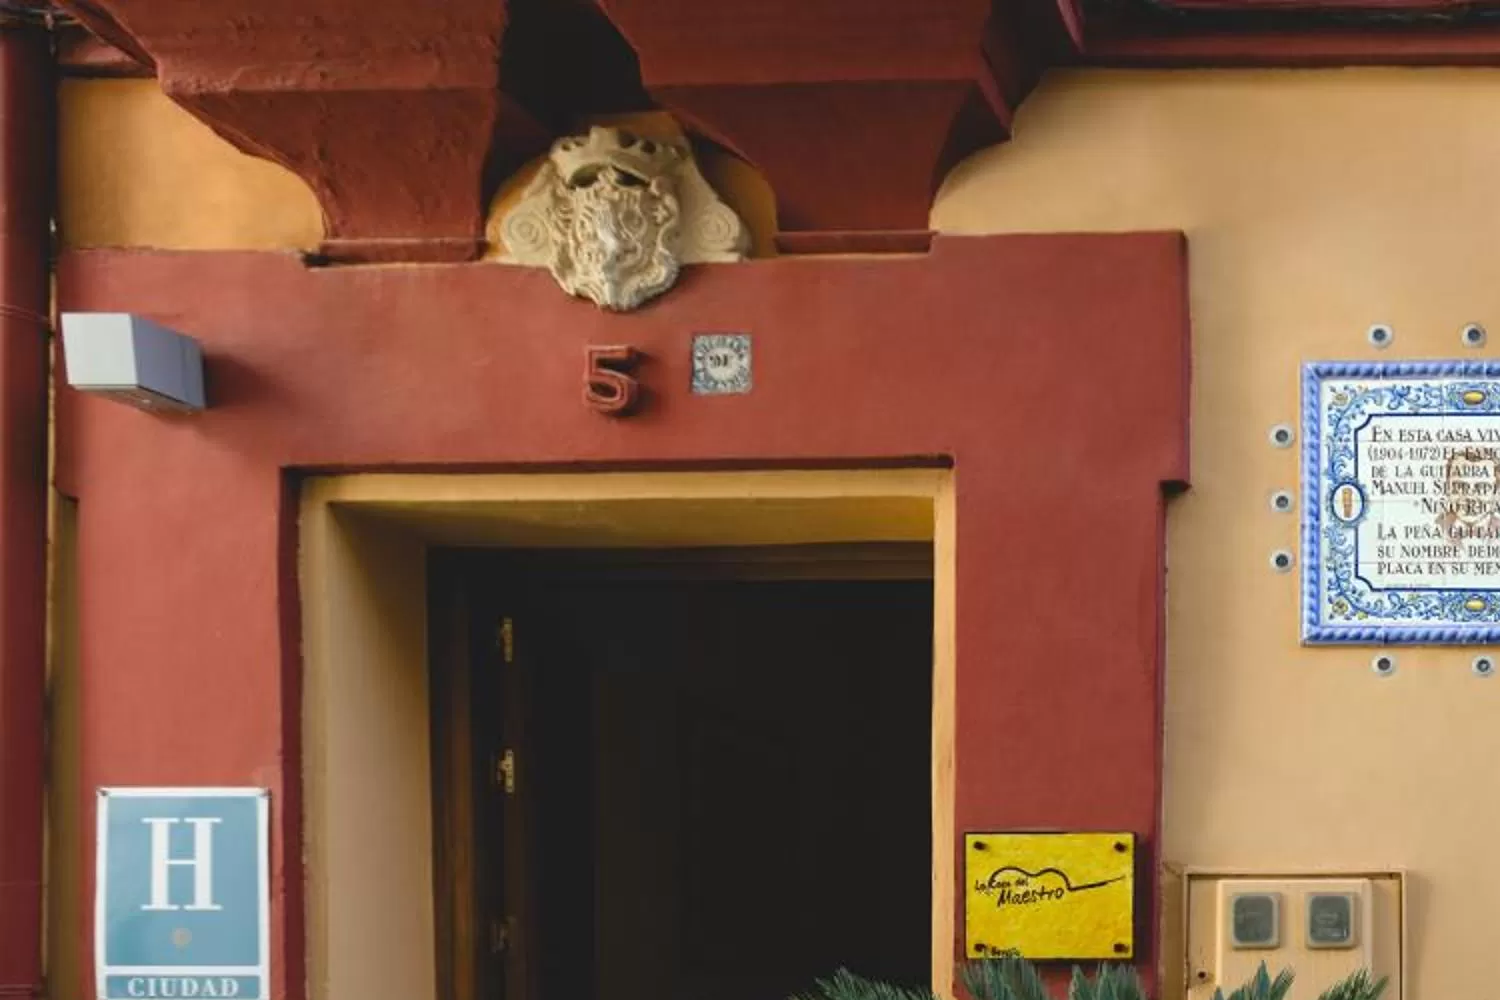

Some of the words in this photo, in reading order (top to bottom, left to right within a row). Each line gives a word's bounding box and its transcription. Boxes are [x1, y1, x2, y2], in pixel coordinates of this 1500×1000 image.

[583, 345, 636, 413] 5
[1371, 425, 1392, 442] EN
[1399, 428, 1432, 442] ESTA
[1435, 428, 1472, 442] CASA
[1371, 465, 1387, 478] DE
[1394, 465, 1413, 478] LA
[1370, 480, 1429, 496] MANUEL
[1377, 522, 1397, 541] LA
[1403, 523, 1442, 539] PEÑA
[1377, 545, 1395, 558] SU
[1400, 545, 1460, 558] NOMBRE
[1377, 562, 1423, 576] PLACA
[1427, 562, 1446, 576] EN
[1450, 562, 1469, 576] SU
[141, 816, 222, 911] H
[997, 885, 1065, 908] Maestro
[127, 977, 240, 997] CIUDAD
